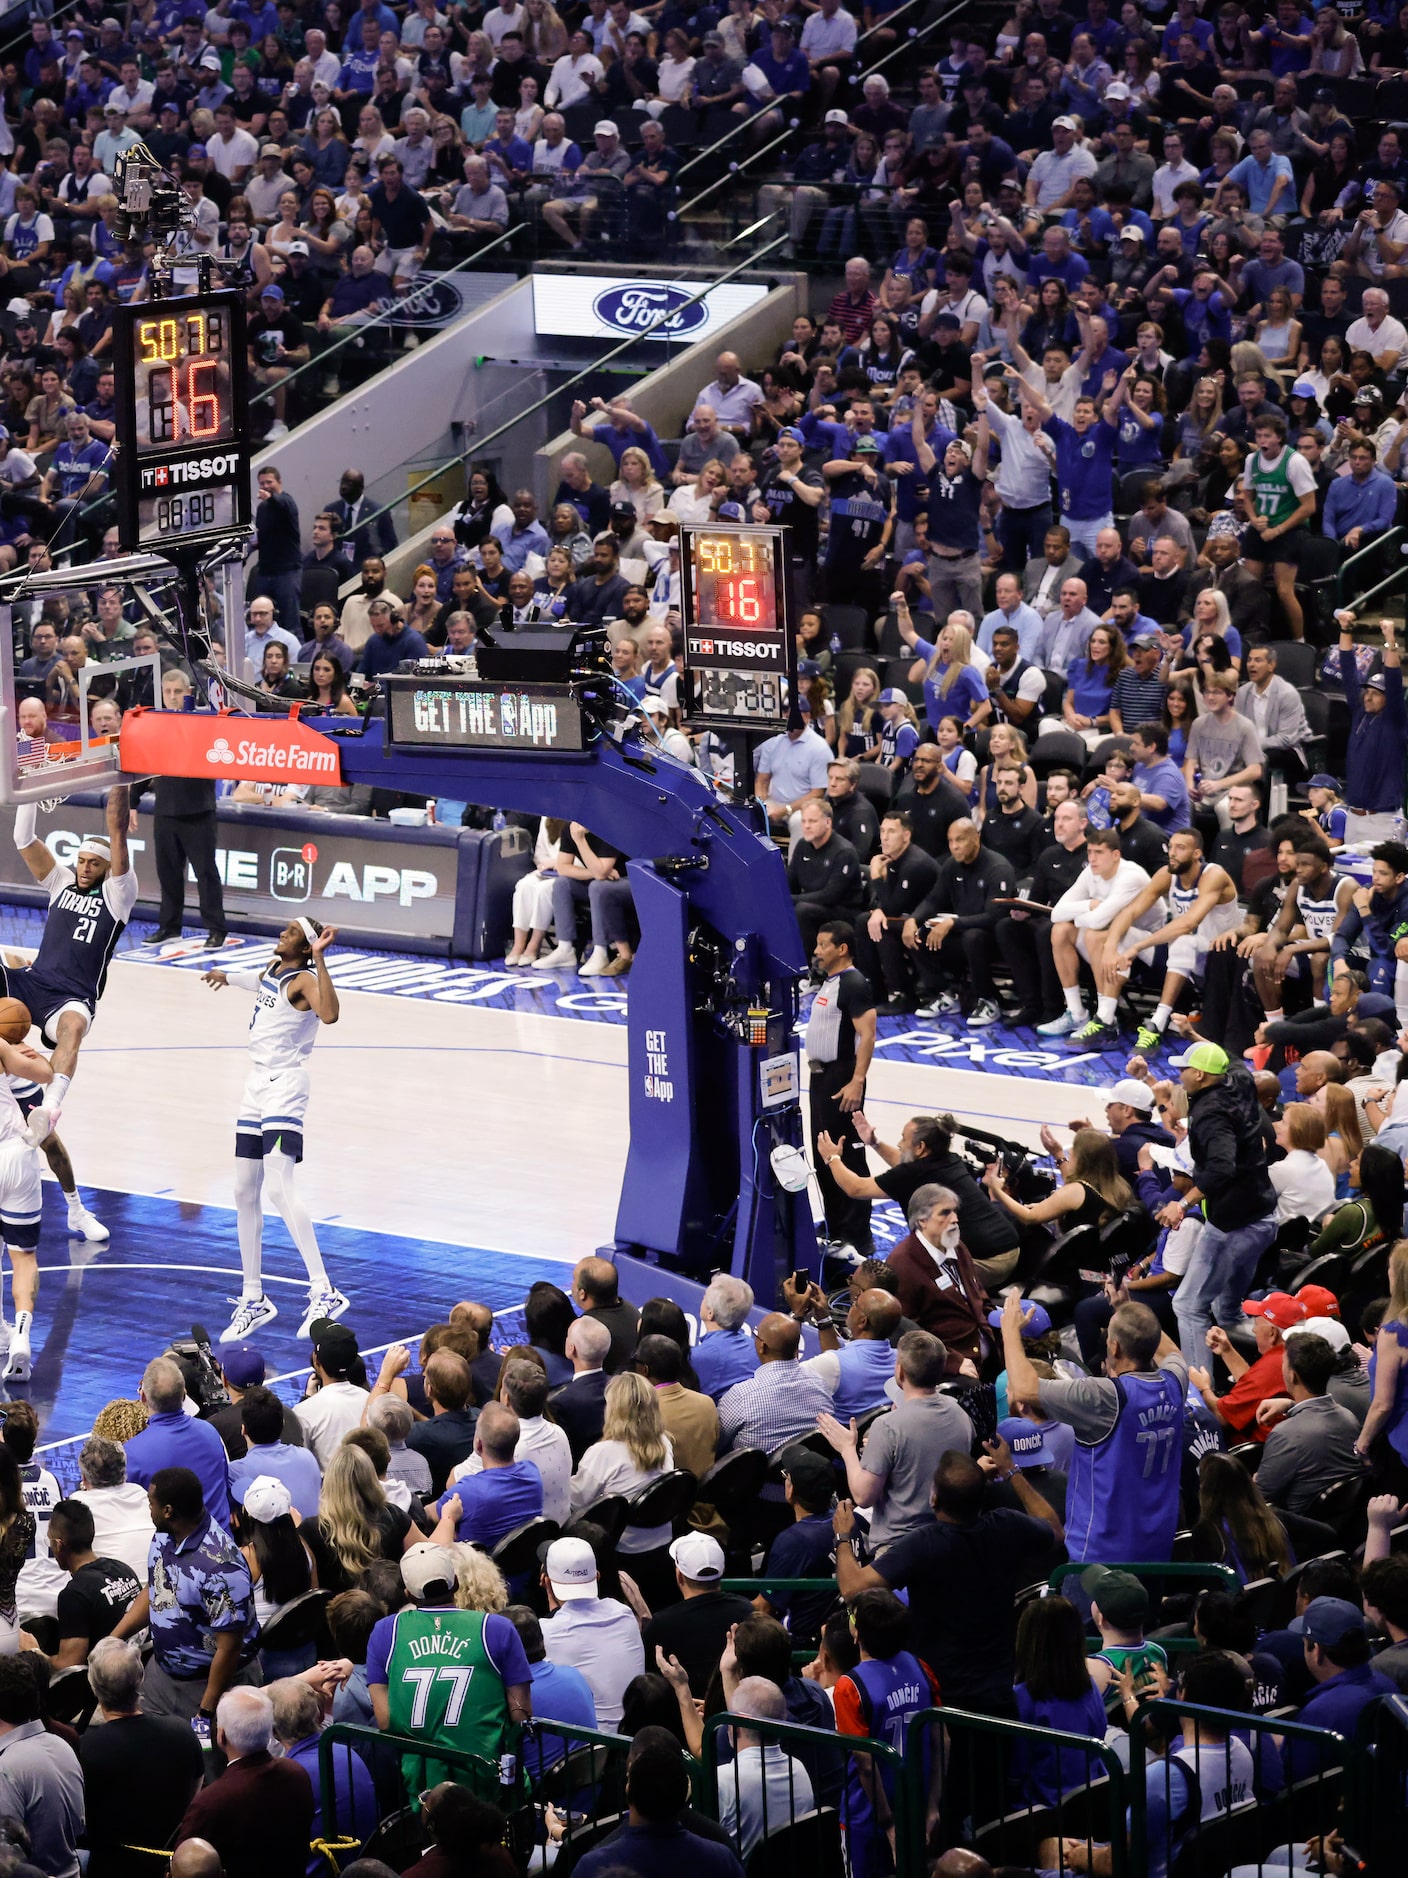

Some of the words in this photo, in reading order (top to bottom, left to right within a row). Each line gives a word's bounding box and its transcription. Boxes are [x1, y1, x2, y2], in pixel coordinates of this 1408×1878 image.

[615, 290, 685, 328] Ford
[169, 453, 239, 485] TISSOT
[1257, 492, 1281, 515] 77
[713, 641, 781, 660] TISSOT
[414, 690, 453, 733] GET
[454, 691, 496, 735] THE
[519, 694, 557, 745] App
[321, 861, 438, 907] APP
[57, 888, 104, 918] MAVS
[72, 917, 98, 944] 21
[645, 1029, 667, 1053] GET
[874, 1030, 1107, 1072] Pixel
[646, 1053, 669, 1076] THE
[654, 1076, 674, 1103] App
[1135, 1426, 1176, 1478] 77
[407, 1630, 472, 1660] DONČIĆ
[402, 1665, 474, 1728] 77
